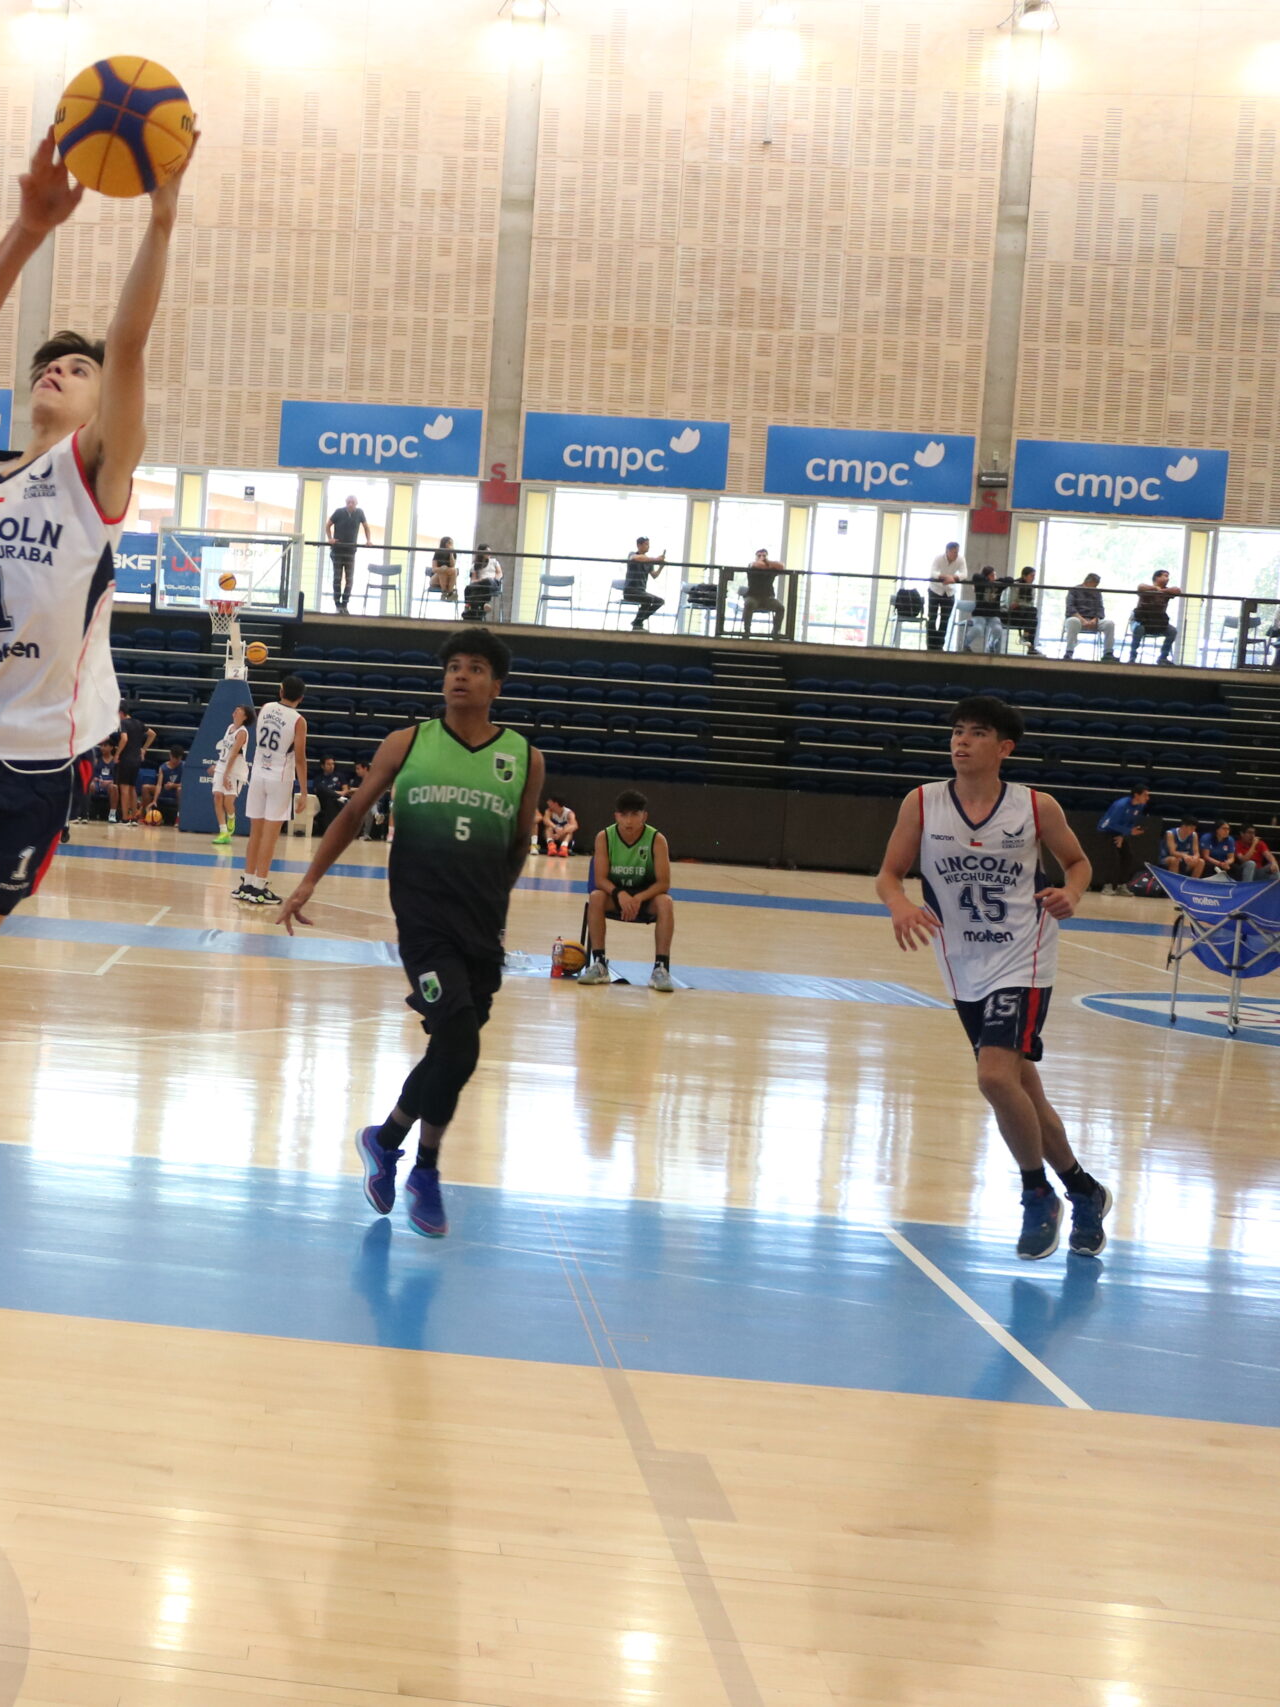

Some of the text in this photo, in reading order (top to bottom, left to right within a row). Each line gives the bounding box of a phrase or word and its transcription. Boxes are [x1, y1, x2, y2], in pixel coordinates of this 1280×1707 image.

[318, 431, 419, 464] cmpc
[563, 444, 665, 477] cmpc
[491, 463, 507, 482] S
[806, 458, 910, 492] cmpc
[1055, 472, 1161, 507] cmpc
[259, 727, 281, 751] 26
[408, 785, 515, 820] COMPOSTELA
[455, 816, 472, 841] 5
[10, 845, 36, 880] 1
[934, 855, 1024, 876] LINCOLN
[943, 873, 1017, 888] HECHURABA
[959, 884, 1008, 924] 45
